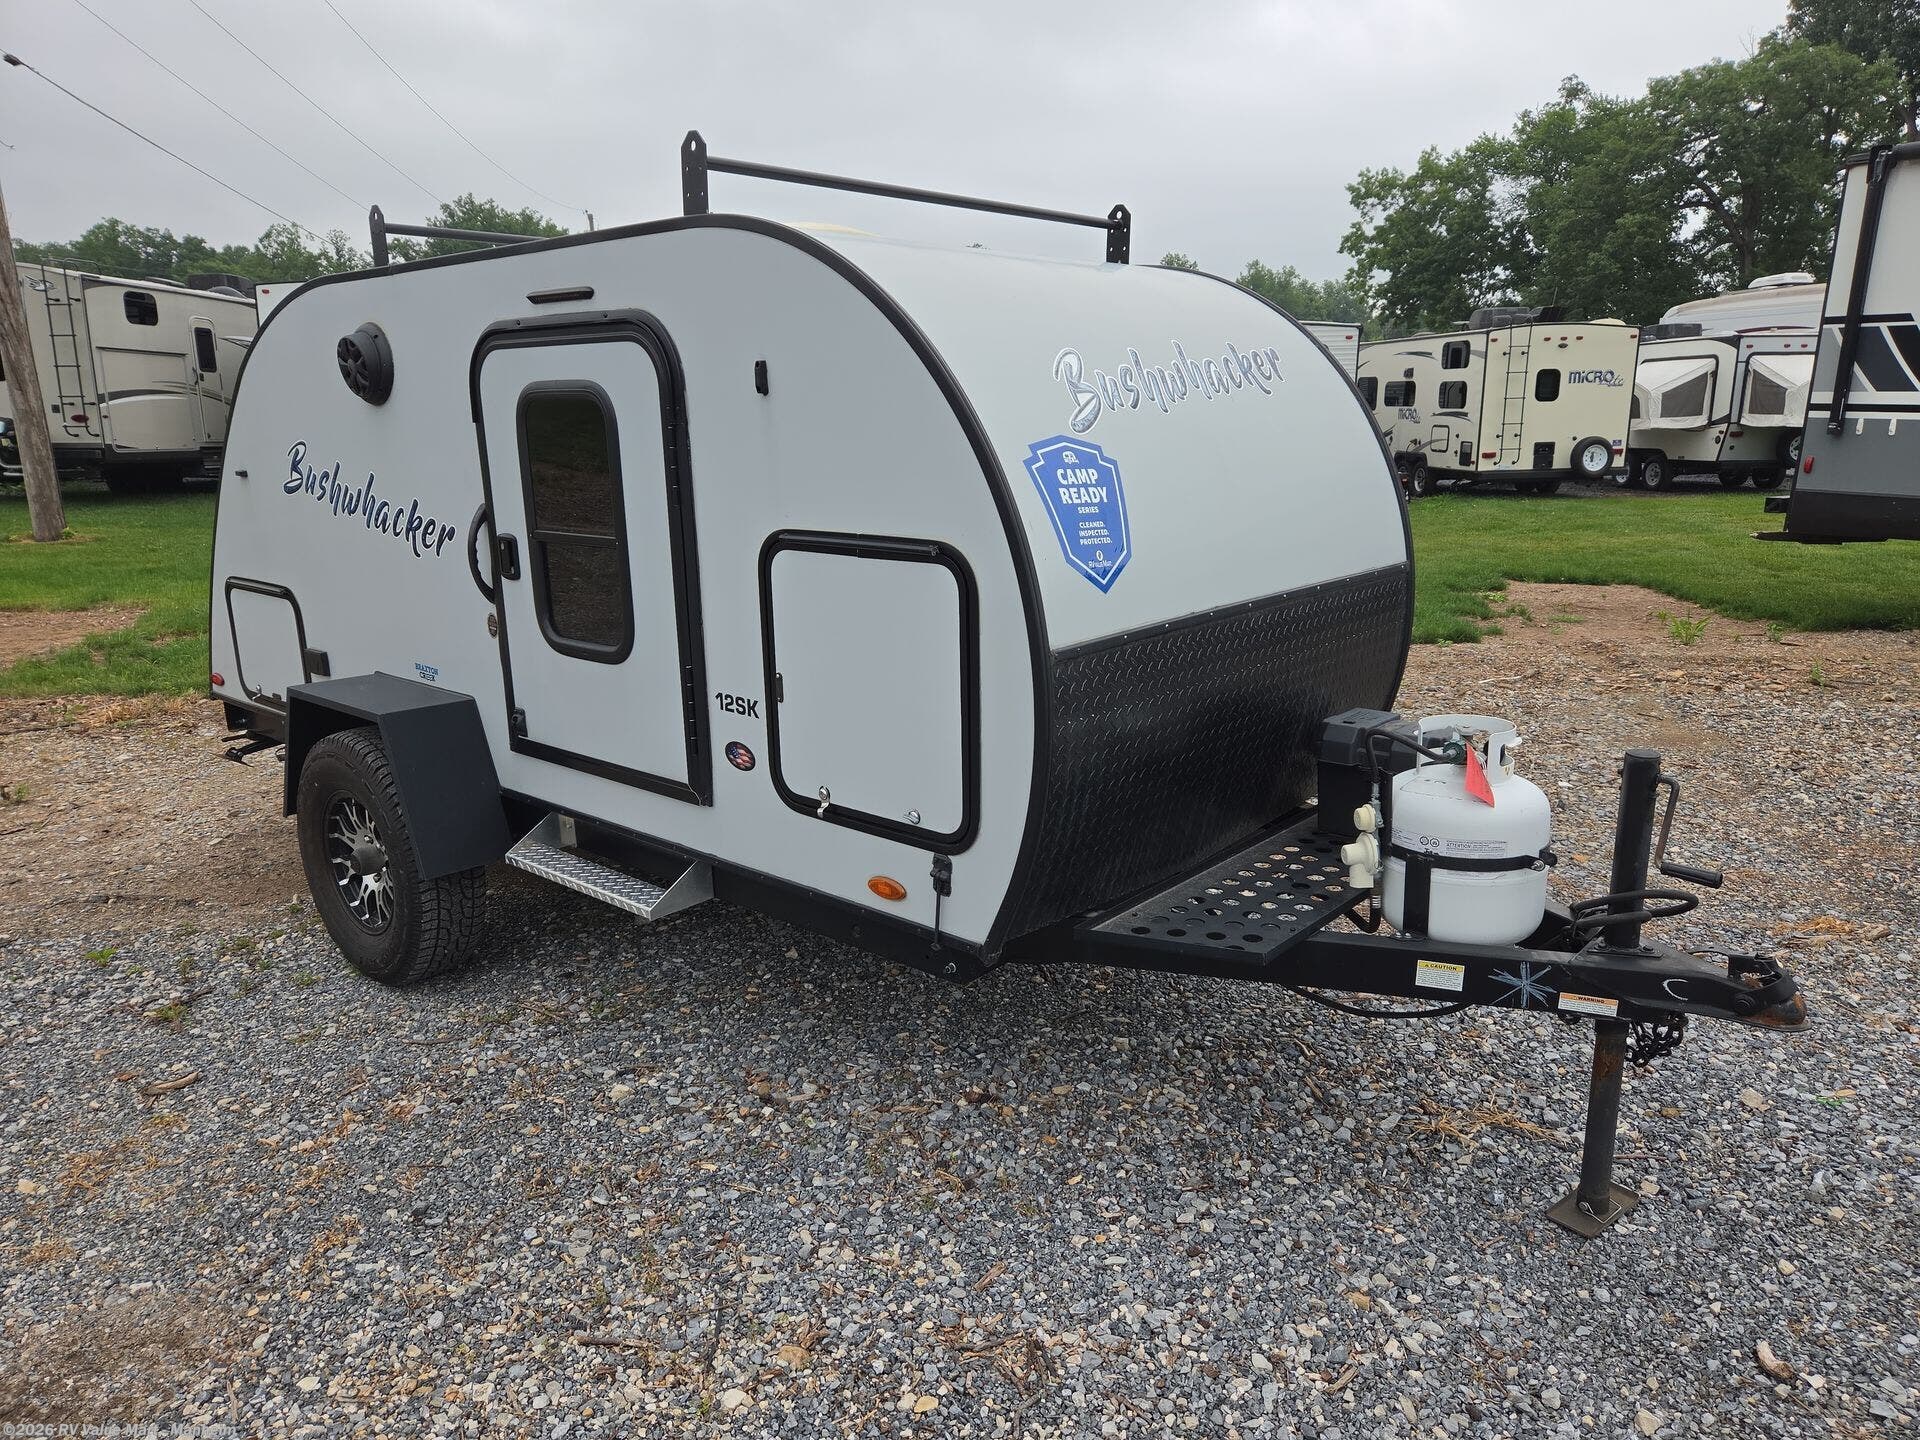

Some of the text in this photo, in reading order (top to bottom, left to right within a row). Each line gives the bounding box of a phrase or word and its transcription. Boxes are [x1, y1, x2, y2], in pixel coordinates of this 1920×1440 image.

[1053, 339, 1285, 434] Bushwhacker
[1056, 468, 1098, 485] CAMP
[282, 439, 457, 559] Bushwhacker
[1058, 486, 1108, 505] READY
[1077, 506, 1099, 514] SERIES
[1079, 529, 1110, 537] INSPECTED.
[1080, 537, 1113, 546] PROTECTED.
[715, 692, 760, 719] 12SK
[1578, 996, 1605, 1004] WARNING
